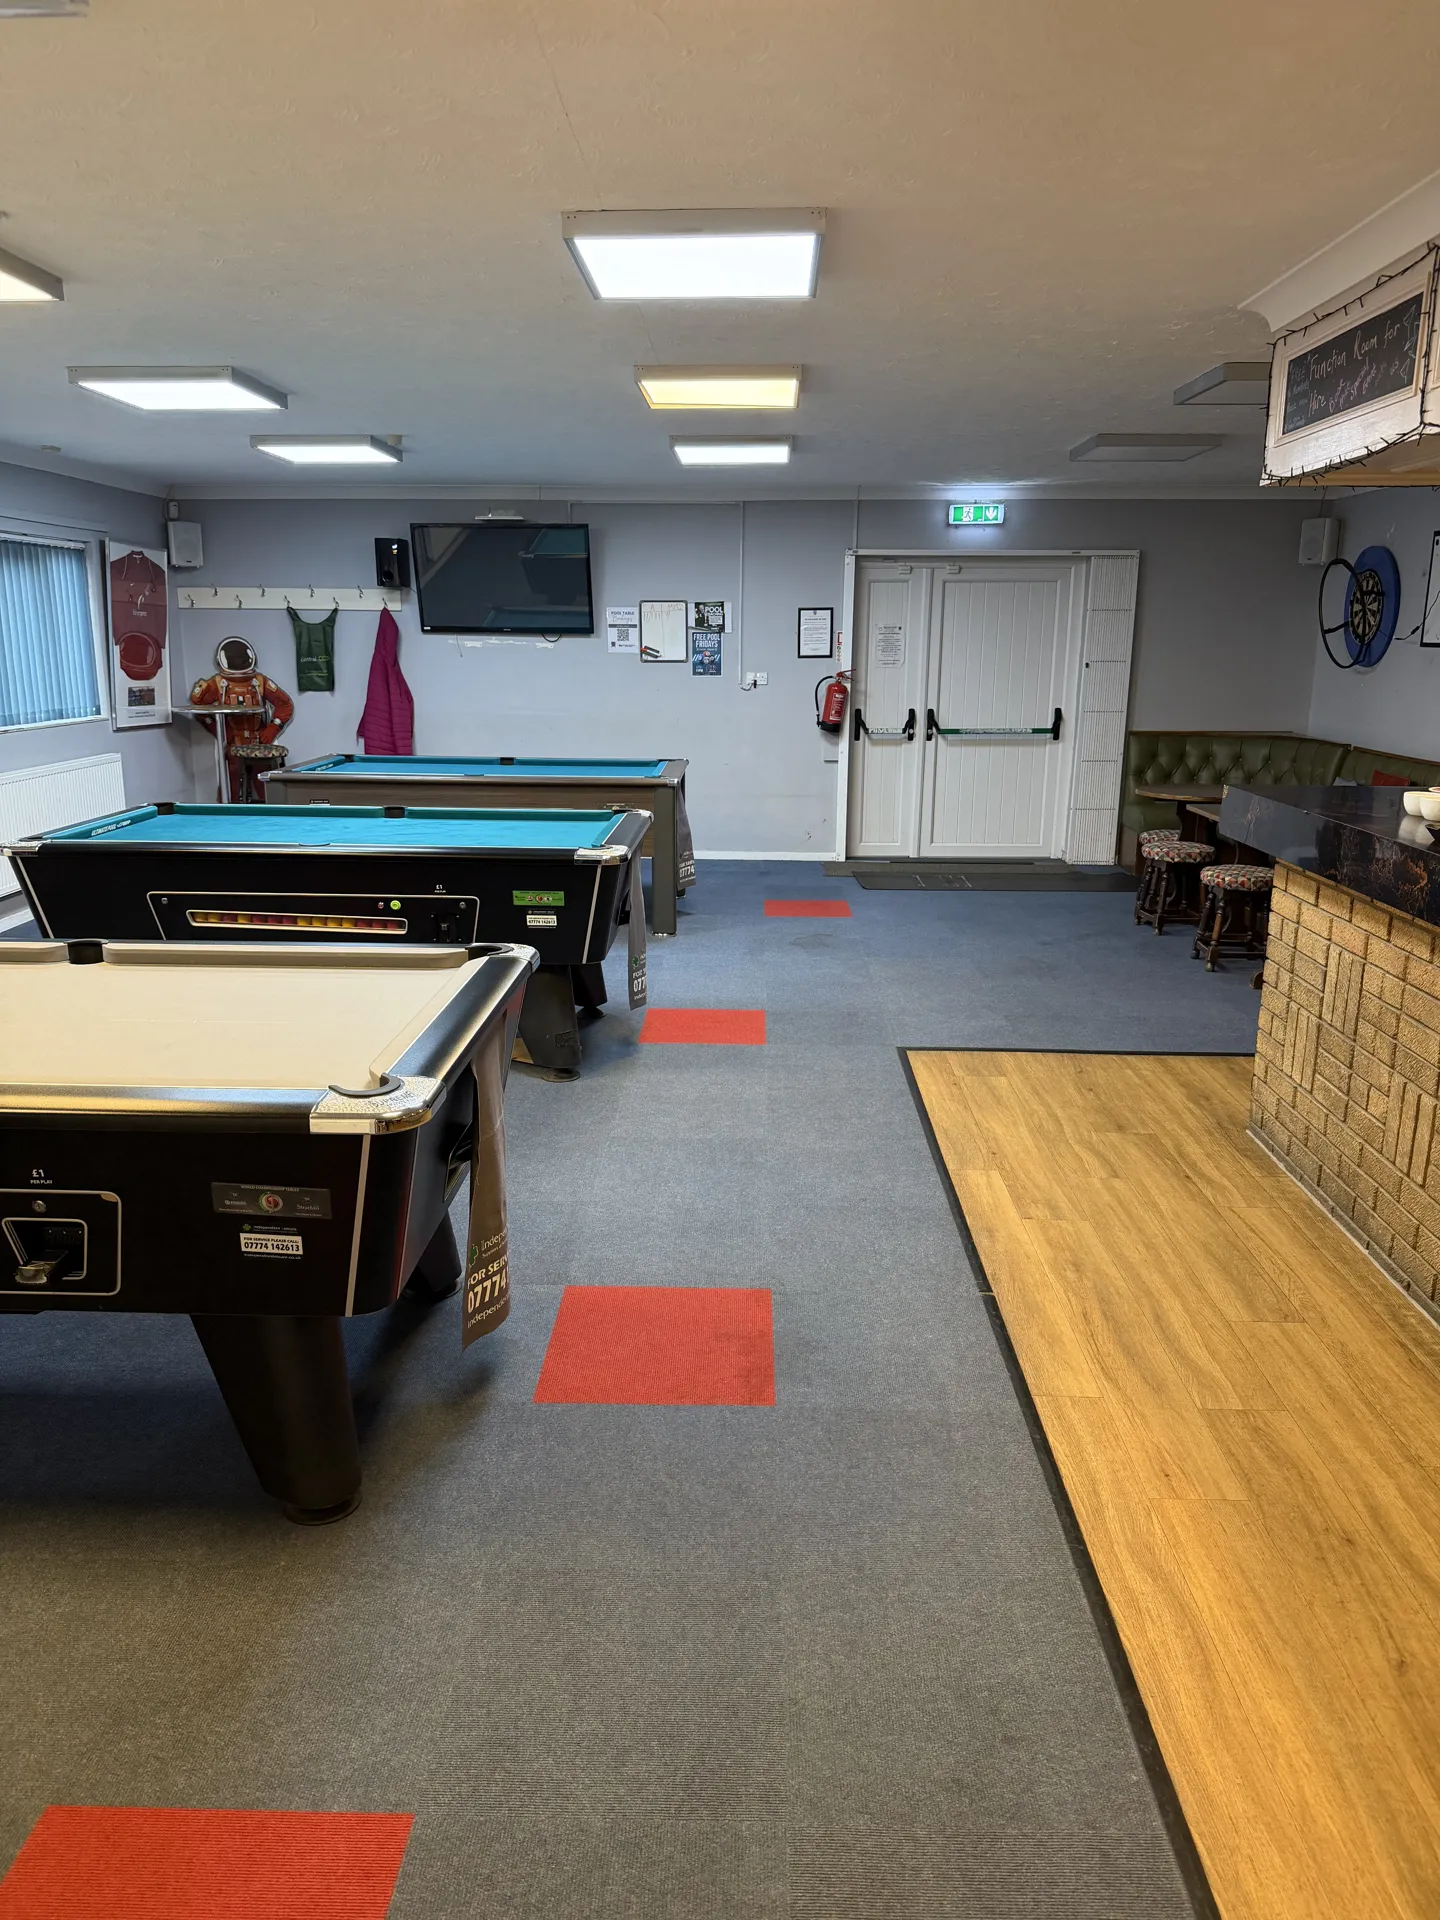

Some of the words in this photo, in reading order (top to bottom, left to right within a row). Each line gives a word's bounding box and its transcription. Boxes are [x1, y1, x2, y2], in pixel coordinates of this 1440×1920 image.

[1309, 351, 1346, 381] Function
[1353, 330, 1378, 360] Room
[1383, 320, 1400, 349] for
[1308, 390, 1327, 417] Hire
[693, 633, 706, 641] FREE
[707, 633, 721, 641] POOL
[695, 640, 719, 648] FRIDAYS
[31, 1168, 45, 1178] £1
[244, 1241, 269, 1250] 07774
[271, 1243, 300, 1252] 142613
[467, 1268, 486, 1289] FOR
[467, 1268, 506, 1314] 07774
